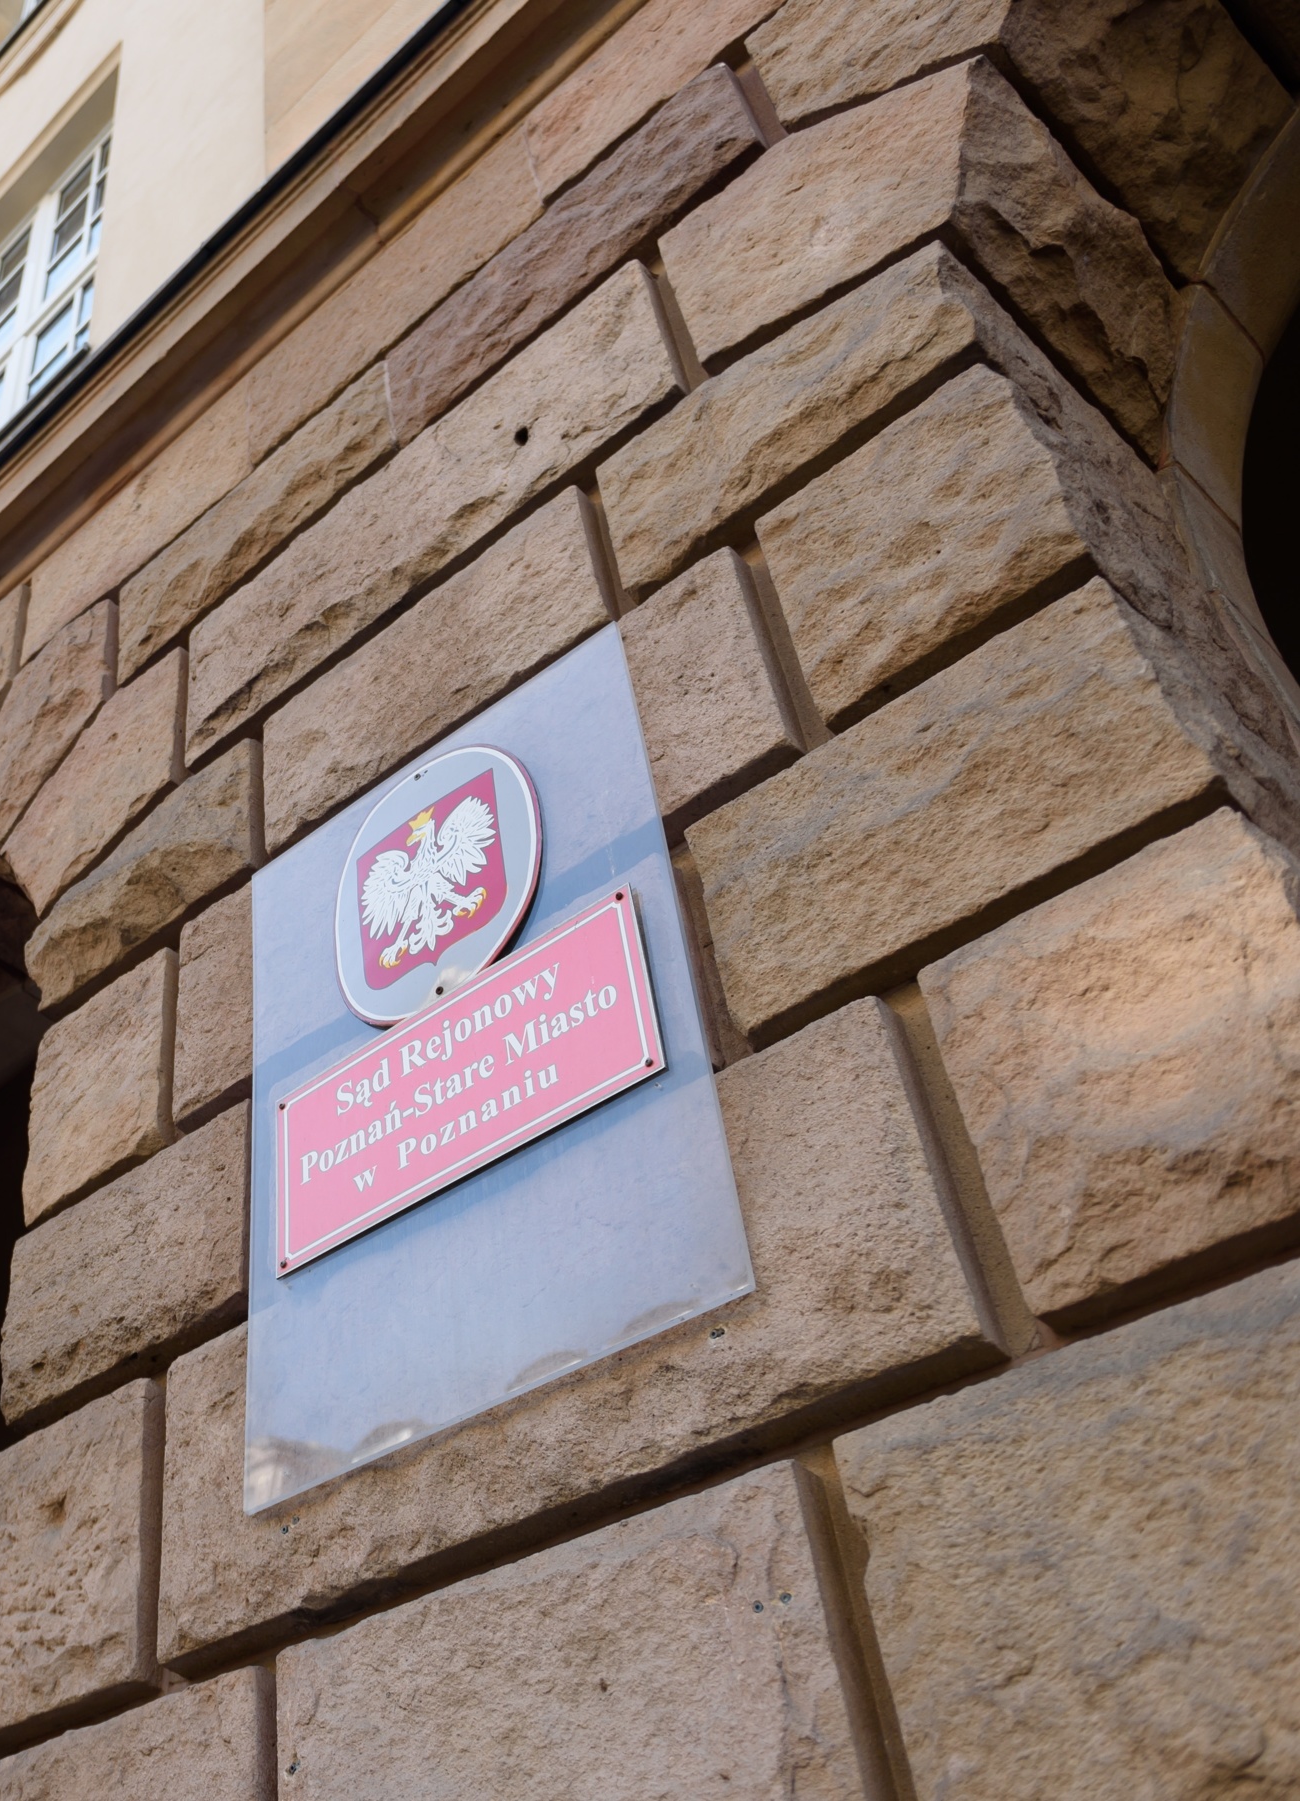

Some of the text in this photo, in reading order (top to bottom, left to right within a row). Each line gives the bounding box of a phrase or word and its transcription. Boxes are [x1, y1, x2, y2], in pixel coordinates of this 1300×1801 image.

[300, 984, 617, 1185] Poznań-Stare Miasto
[336, 962, 560, 1116] Sąd Rejonowy
[353, 1063, 560, 1193] w Poznaniu
